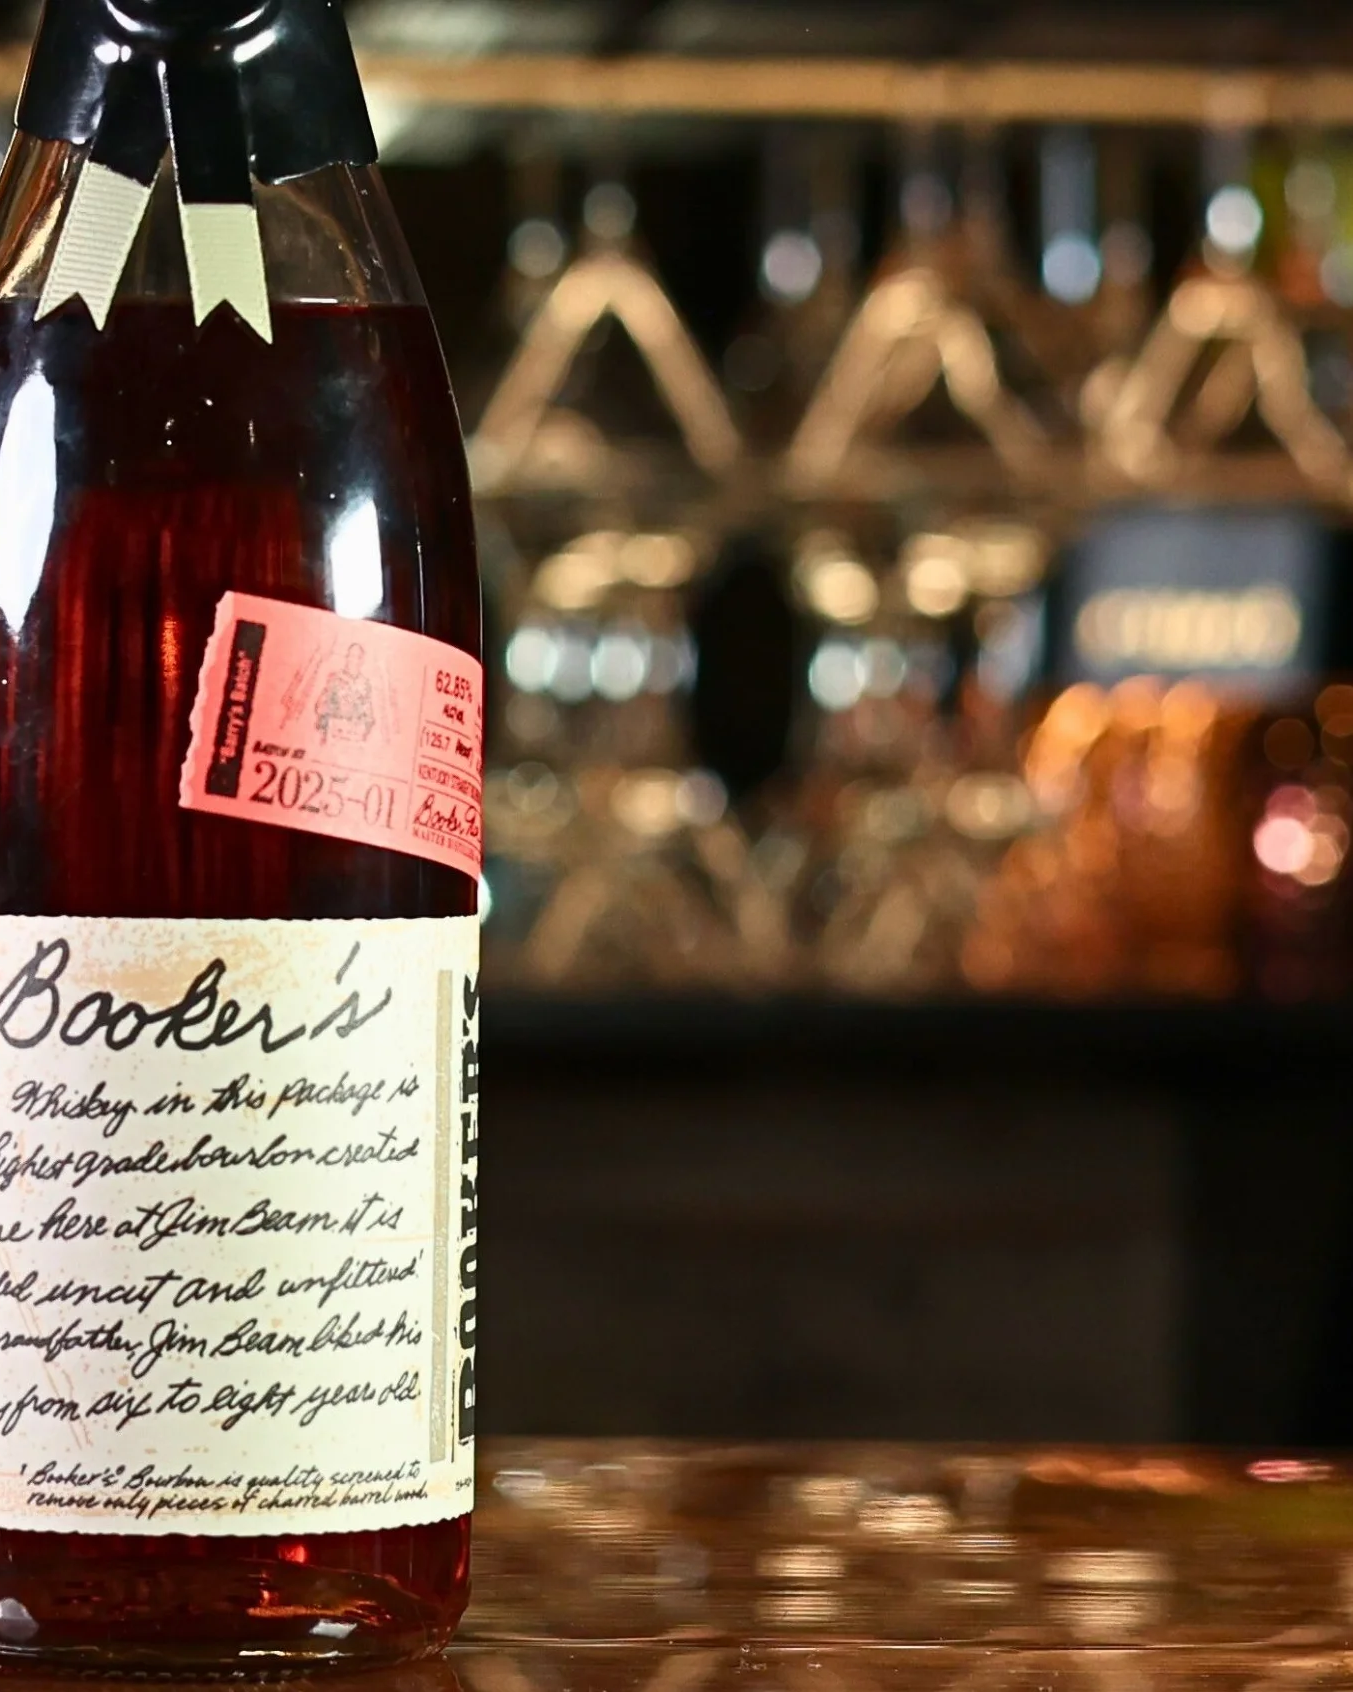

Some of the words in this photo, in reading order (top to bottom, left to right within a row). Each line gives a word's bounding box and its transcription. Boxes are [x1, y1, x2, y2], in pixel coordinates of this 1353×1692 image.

[249, 759, 398, 831] 2025-01
[143, 1081, 196, 1116] in
[202, 1073, 267, 1116] this
[387, 1074, 420, 1103] is
[169, 1133, 315, 1170] bourbon
[316, 1125, 420, 1168] created
[38, 1196, 107, 1241] here
[113, 1201, 166, 1238] at
[138, 1196, 231, 1251] Jim
[366, 1205, 404, 1232] is
[34, 1269, 183, 1314] uncut
[131, 1318, 208, 1380] Jim
[209, 1318, 307, 1358] Beam
[304, 1311, 387, 1352] liked
[384, 1310, 423, 1348] his
[1, 1384, 81, 1436] from
[85, 1386, 153, 1431] six
[155, 1377, 203, 1414] to
[200, 1379, 297, 1432] eight
[289, 1381, 377, 1428] years
[122, 1464, 215, 1490] Bourbon
[221, 1470, 245, 1488] is
[246, 1464, 325, 1495] quality
[330, 1461, 405, 1487] screened
[405, 1459, 421, 1480] to
[26, 1491, 102, 1508] remove
[102, 1487, 149, 1521] only
[147, 1493, 228, 1521] pieces
[230, 1487, 259, 1513] of
[257, 1486, 339, 1511] charred
[338, 1483, 395, 1508] barrel
